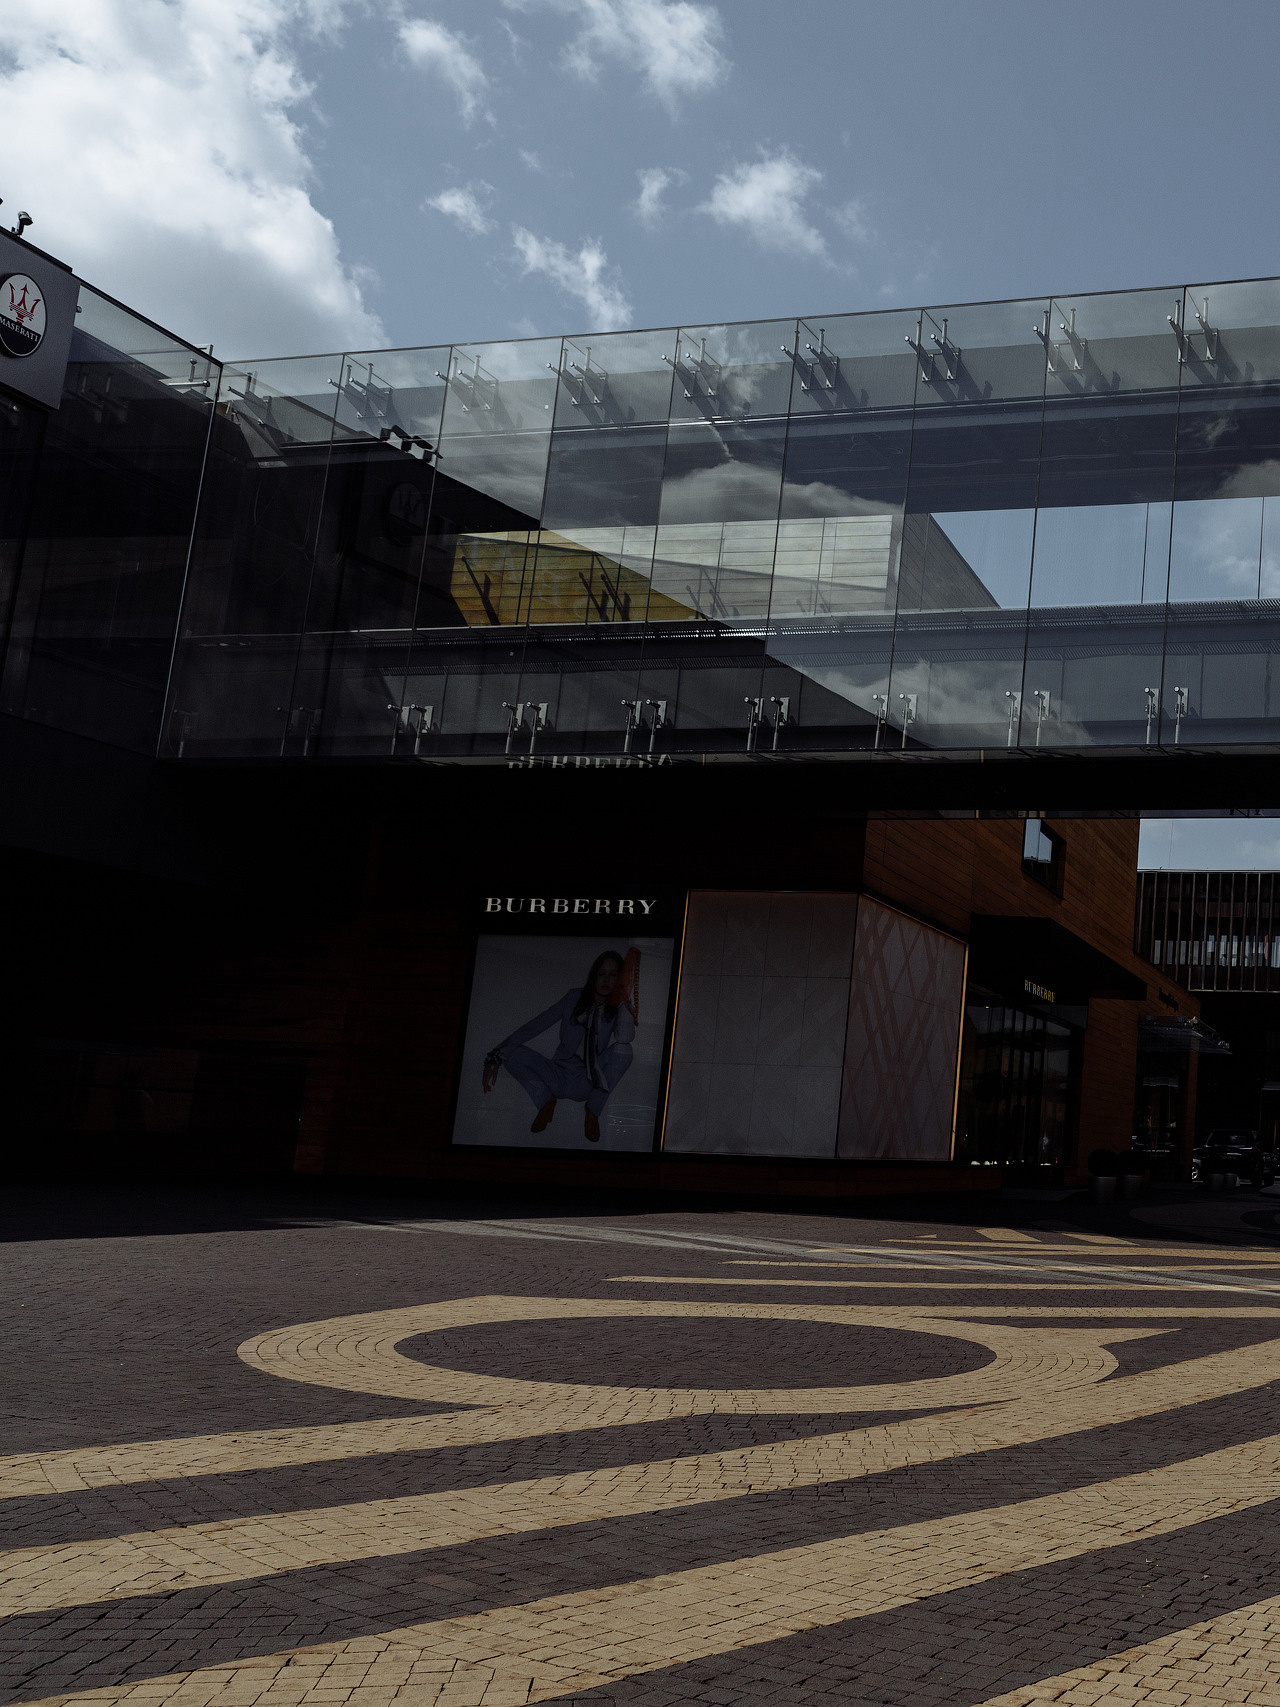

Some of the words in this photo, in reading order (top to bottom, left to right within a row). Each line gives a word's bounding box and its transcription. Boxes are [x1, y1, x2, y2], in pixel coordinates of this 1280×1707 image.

[0, 316, 38, 342] MASERATI
[484, 897, 656, 914] BURBERRY
[1024, 979, 1056, 1003] BURBERRY
